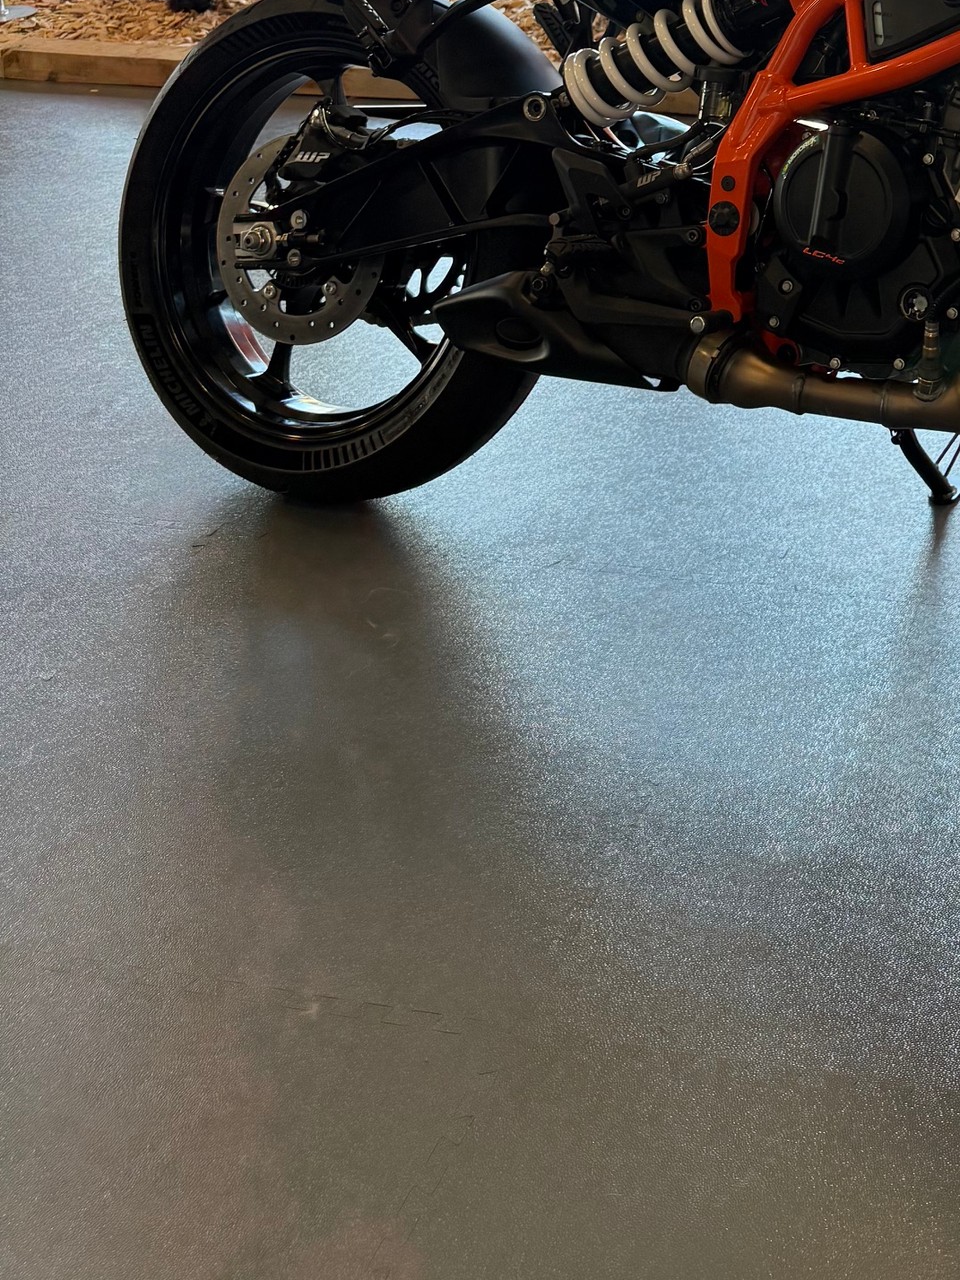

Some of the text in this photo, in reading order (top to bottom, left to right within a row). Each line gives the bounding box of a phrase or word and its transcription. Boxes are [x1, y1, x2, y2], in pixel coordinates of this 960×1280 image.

[296, 151, 331, 163] WP
[636, 170, 663, 188] WP
[138, 323, 202, 417] MICHELIN
